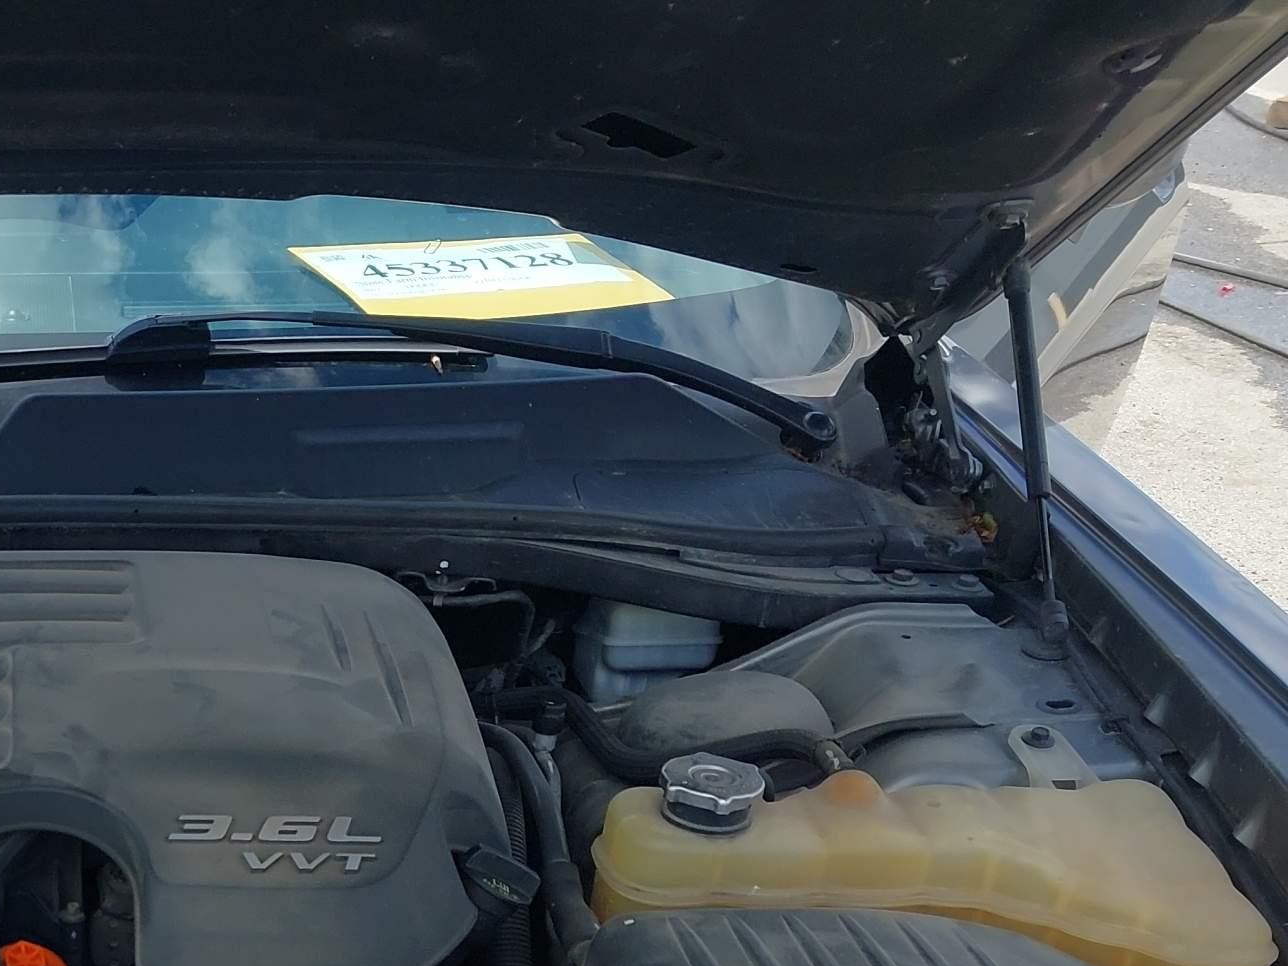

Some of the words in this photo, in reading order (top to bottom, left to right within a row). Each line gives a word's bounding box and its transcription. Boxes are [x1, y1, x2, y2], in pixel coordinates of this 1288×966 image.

[362, 252, 574, 278] 45337128
[168, 815, 383, 843] 3.6L
[242, 851, 378, 873] VVT
